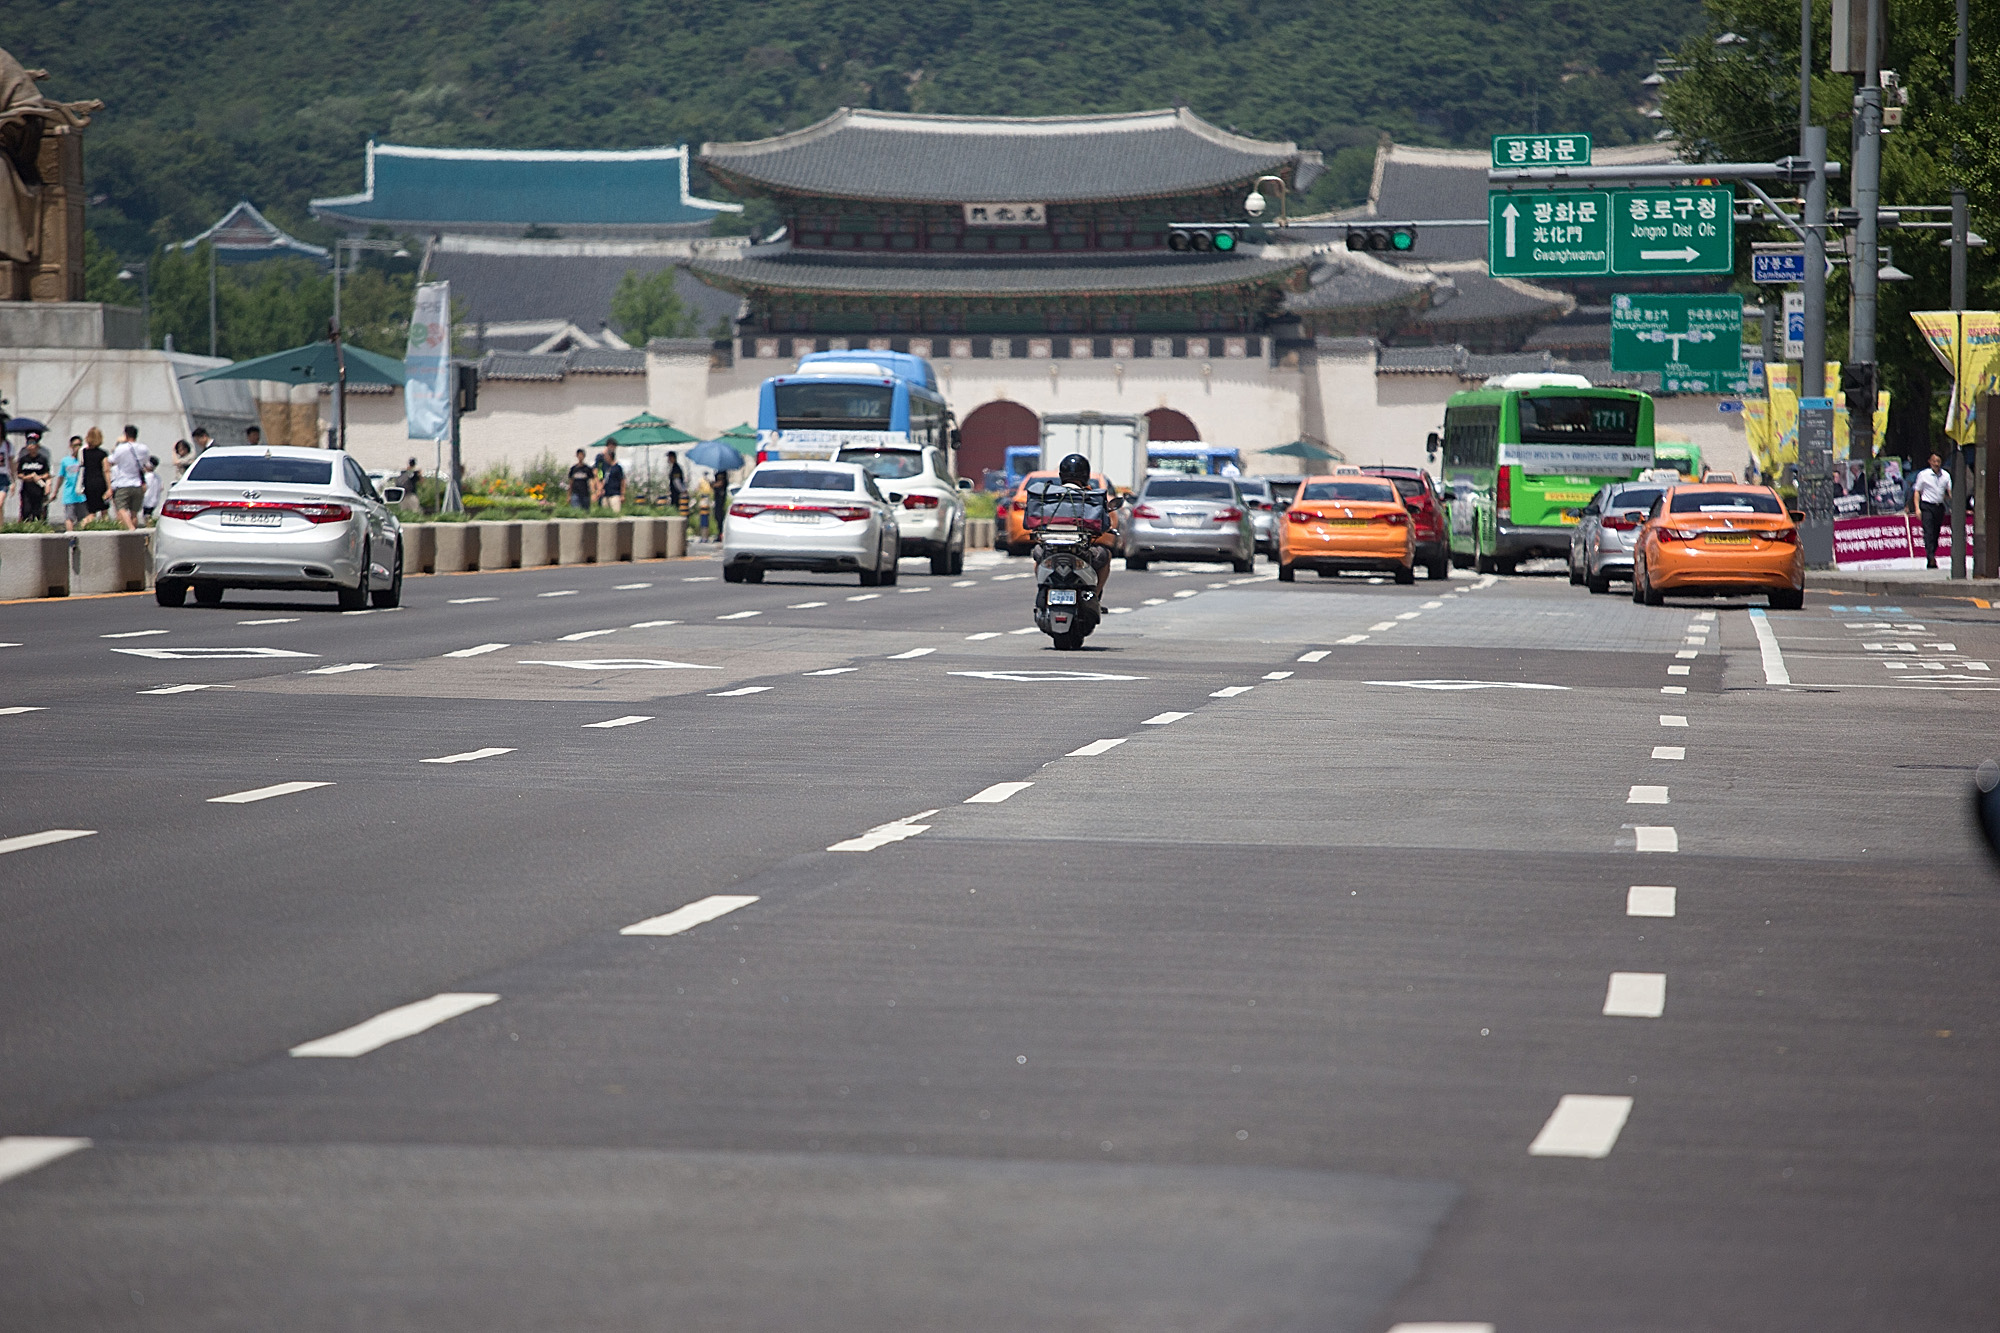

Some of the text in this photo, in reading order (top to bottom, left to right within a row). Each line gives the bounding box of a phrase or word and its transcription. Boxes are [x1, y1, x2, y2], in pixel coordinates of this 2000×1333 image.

[1508, 139, 1576, 162] 광화문
[1533, 201, 1597, 223] 광화문
[1629, 197, 1716, 220] 종로구청
[1533, 226, 1582, 243] 光化門
[1631, 223, 1668, 241] Jongno
[1672, 222, 1693, 237] Dist
[1532, 247, 1606, 264] Gwanghwamun
[1594, 411, 1625, 428] 1711
